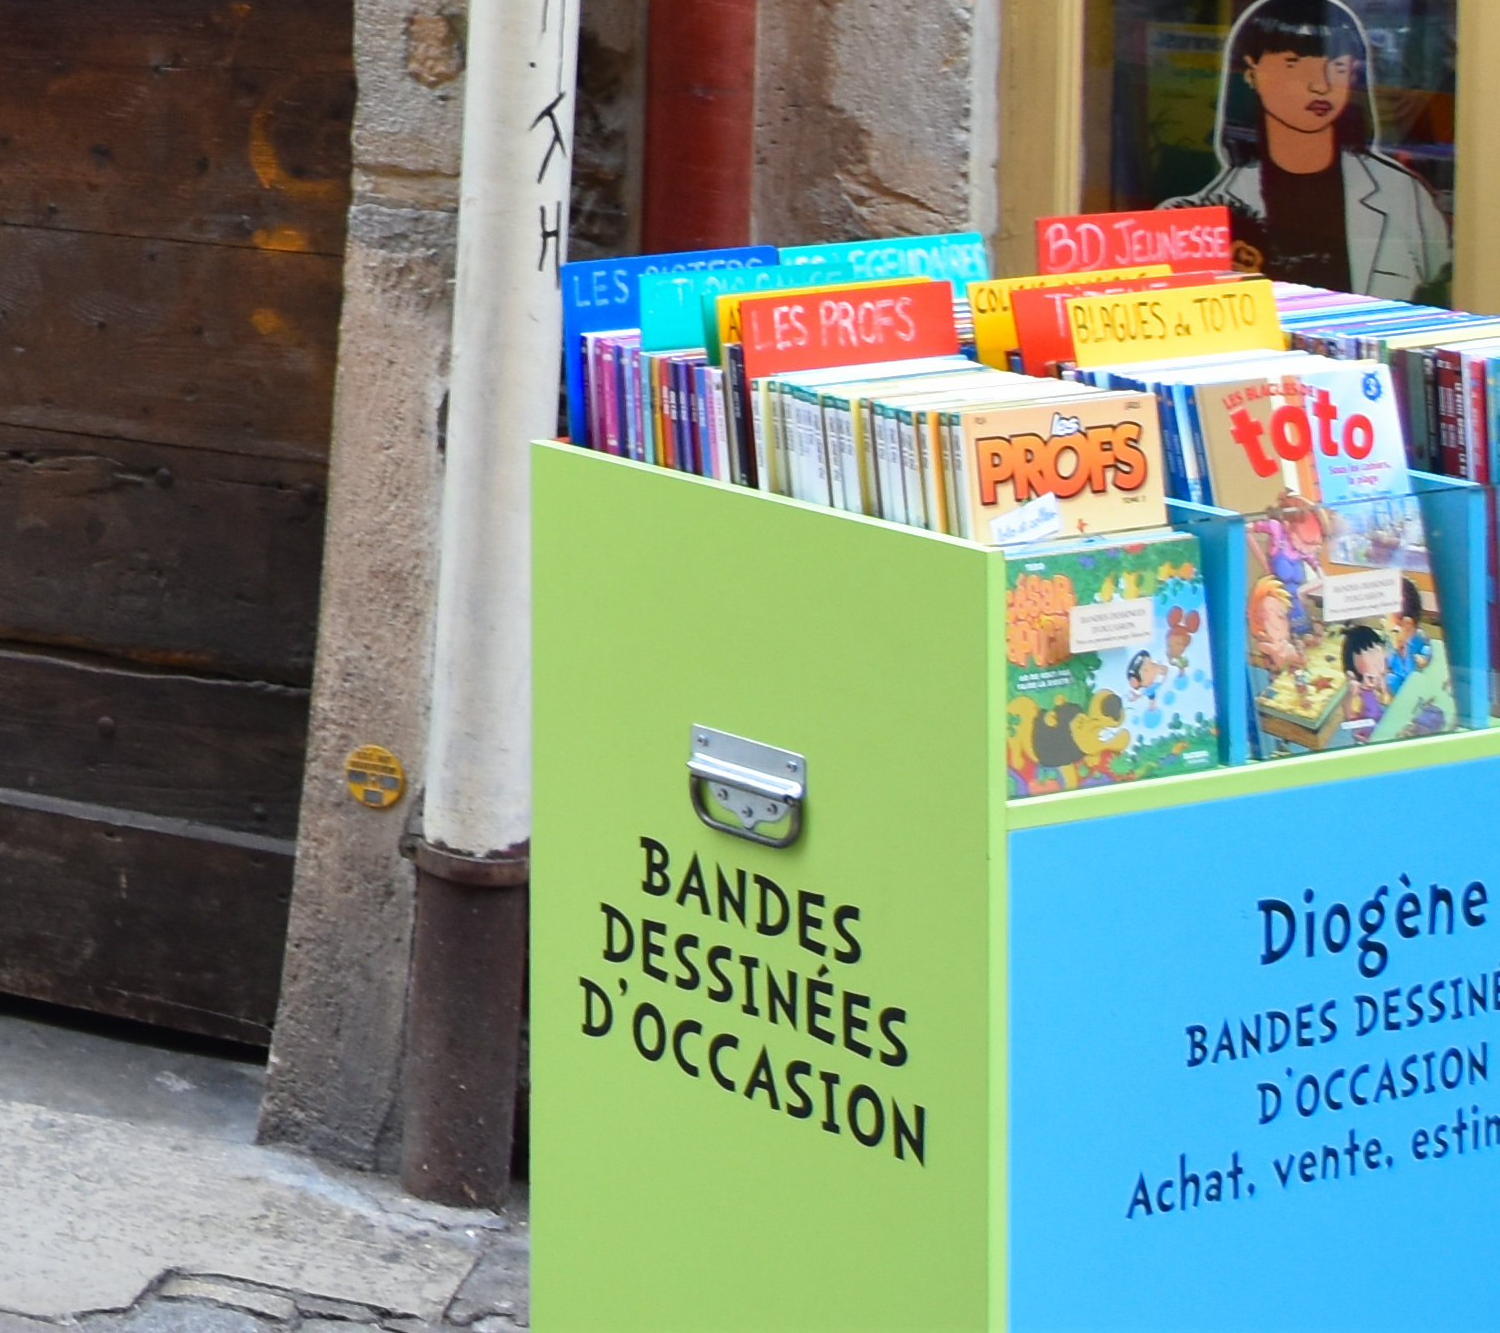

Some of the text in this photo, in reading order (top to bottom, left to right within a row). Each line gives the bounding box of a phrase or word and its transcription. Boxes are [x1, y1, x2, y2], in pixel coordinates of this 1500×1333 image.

[573, 268, 631, 309] LES
[1044, 222, 1107, 273] BD
[751, 300, 810, 351] LES
[818, 296, 916, 349] PROFS
[1073, 299, 1167, 344] BLAGUES
[1194, 291, 1257, 334] TOTO
[974, 419, 1149, 507] PROFS
[1229, 388, 1375, 479] toto
[639, 836, 861, 965] BANDES
[1257, 872, 1488, 978] Diogène
[600, 901, 908, 1067] DESSINÉES
[579, 976, 925, 1167] D'OCCASION
[1185, 999, 1337, 1068] BANDES
[1256, 1041, 1488, 1125] D'OCCASION
